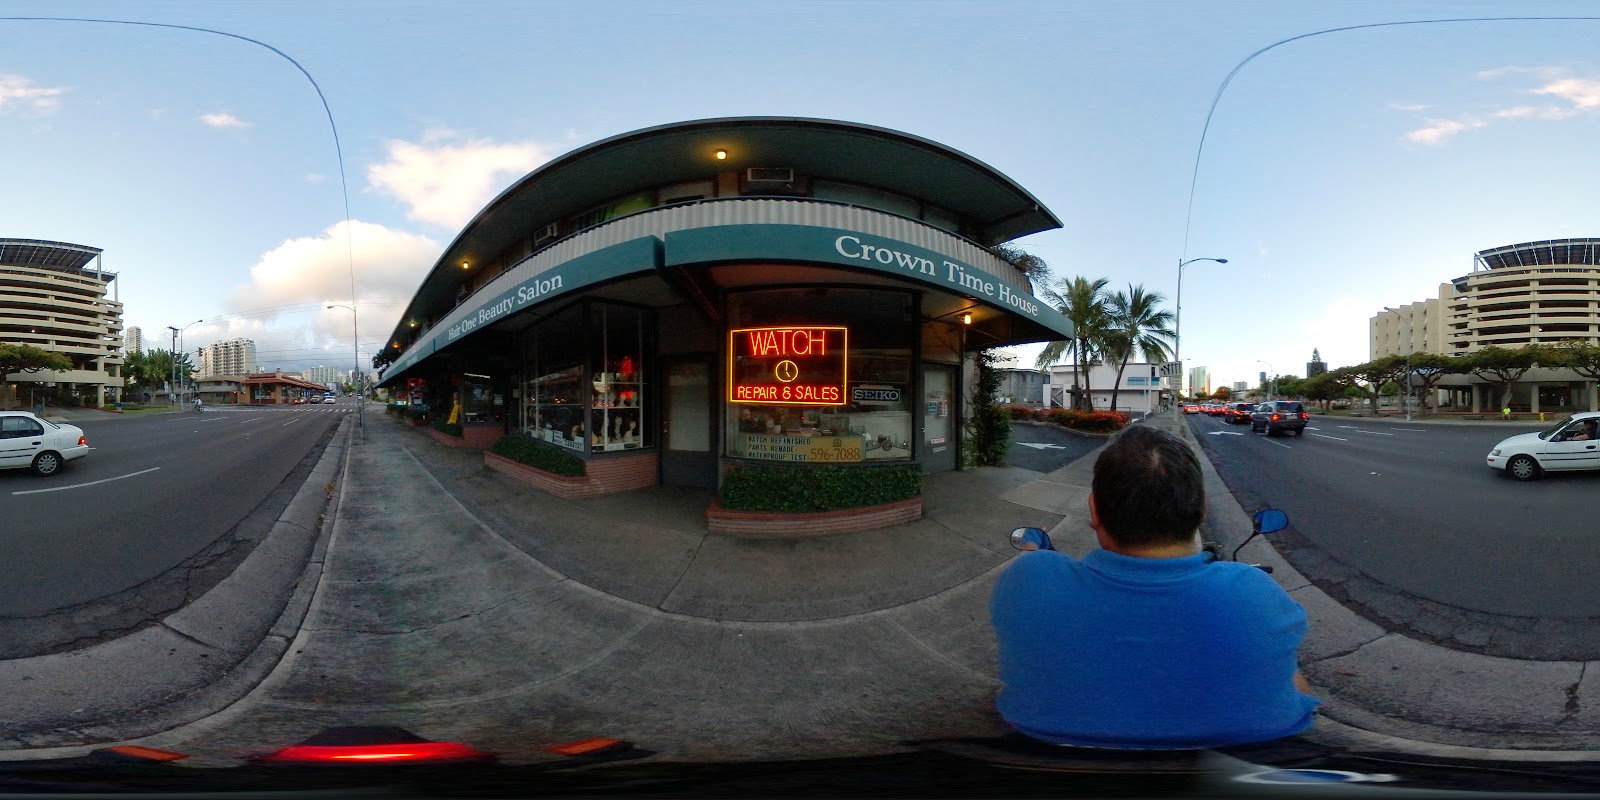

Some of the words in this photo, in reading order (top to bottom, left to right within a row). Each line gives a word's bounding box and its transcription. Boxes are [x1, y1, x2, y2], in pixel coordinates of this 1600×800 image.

[835, 235, 936, 276] Crown
[943, 260, 994, 296] Time
[999, 283, 1038, 317] House
[448, 325, 461, 341] Hair
[461, 317, 477, 333] One
[478, 296, 515, 325] Beauty
[517, 274, 563, 305] Salon
[750, 330, 825, 356] WATCH
[737, 385, 777, 400] REPAIR
[782, 386, 791, 400] &
[795, 385, 839, 400] SALES
[854, 389, 899, 401] SEIKO
[748, 443, 768, 451] PARTS
[810, 447, 861, 461] 596-7088
